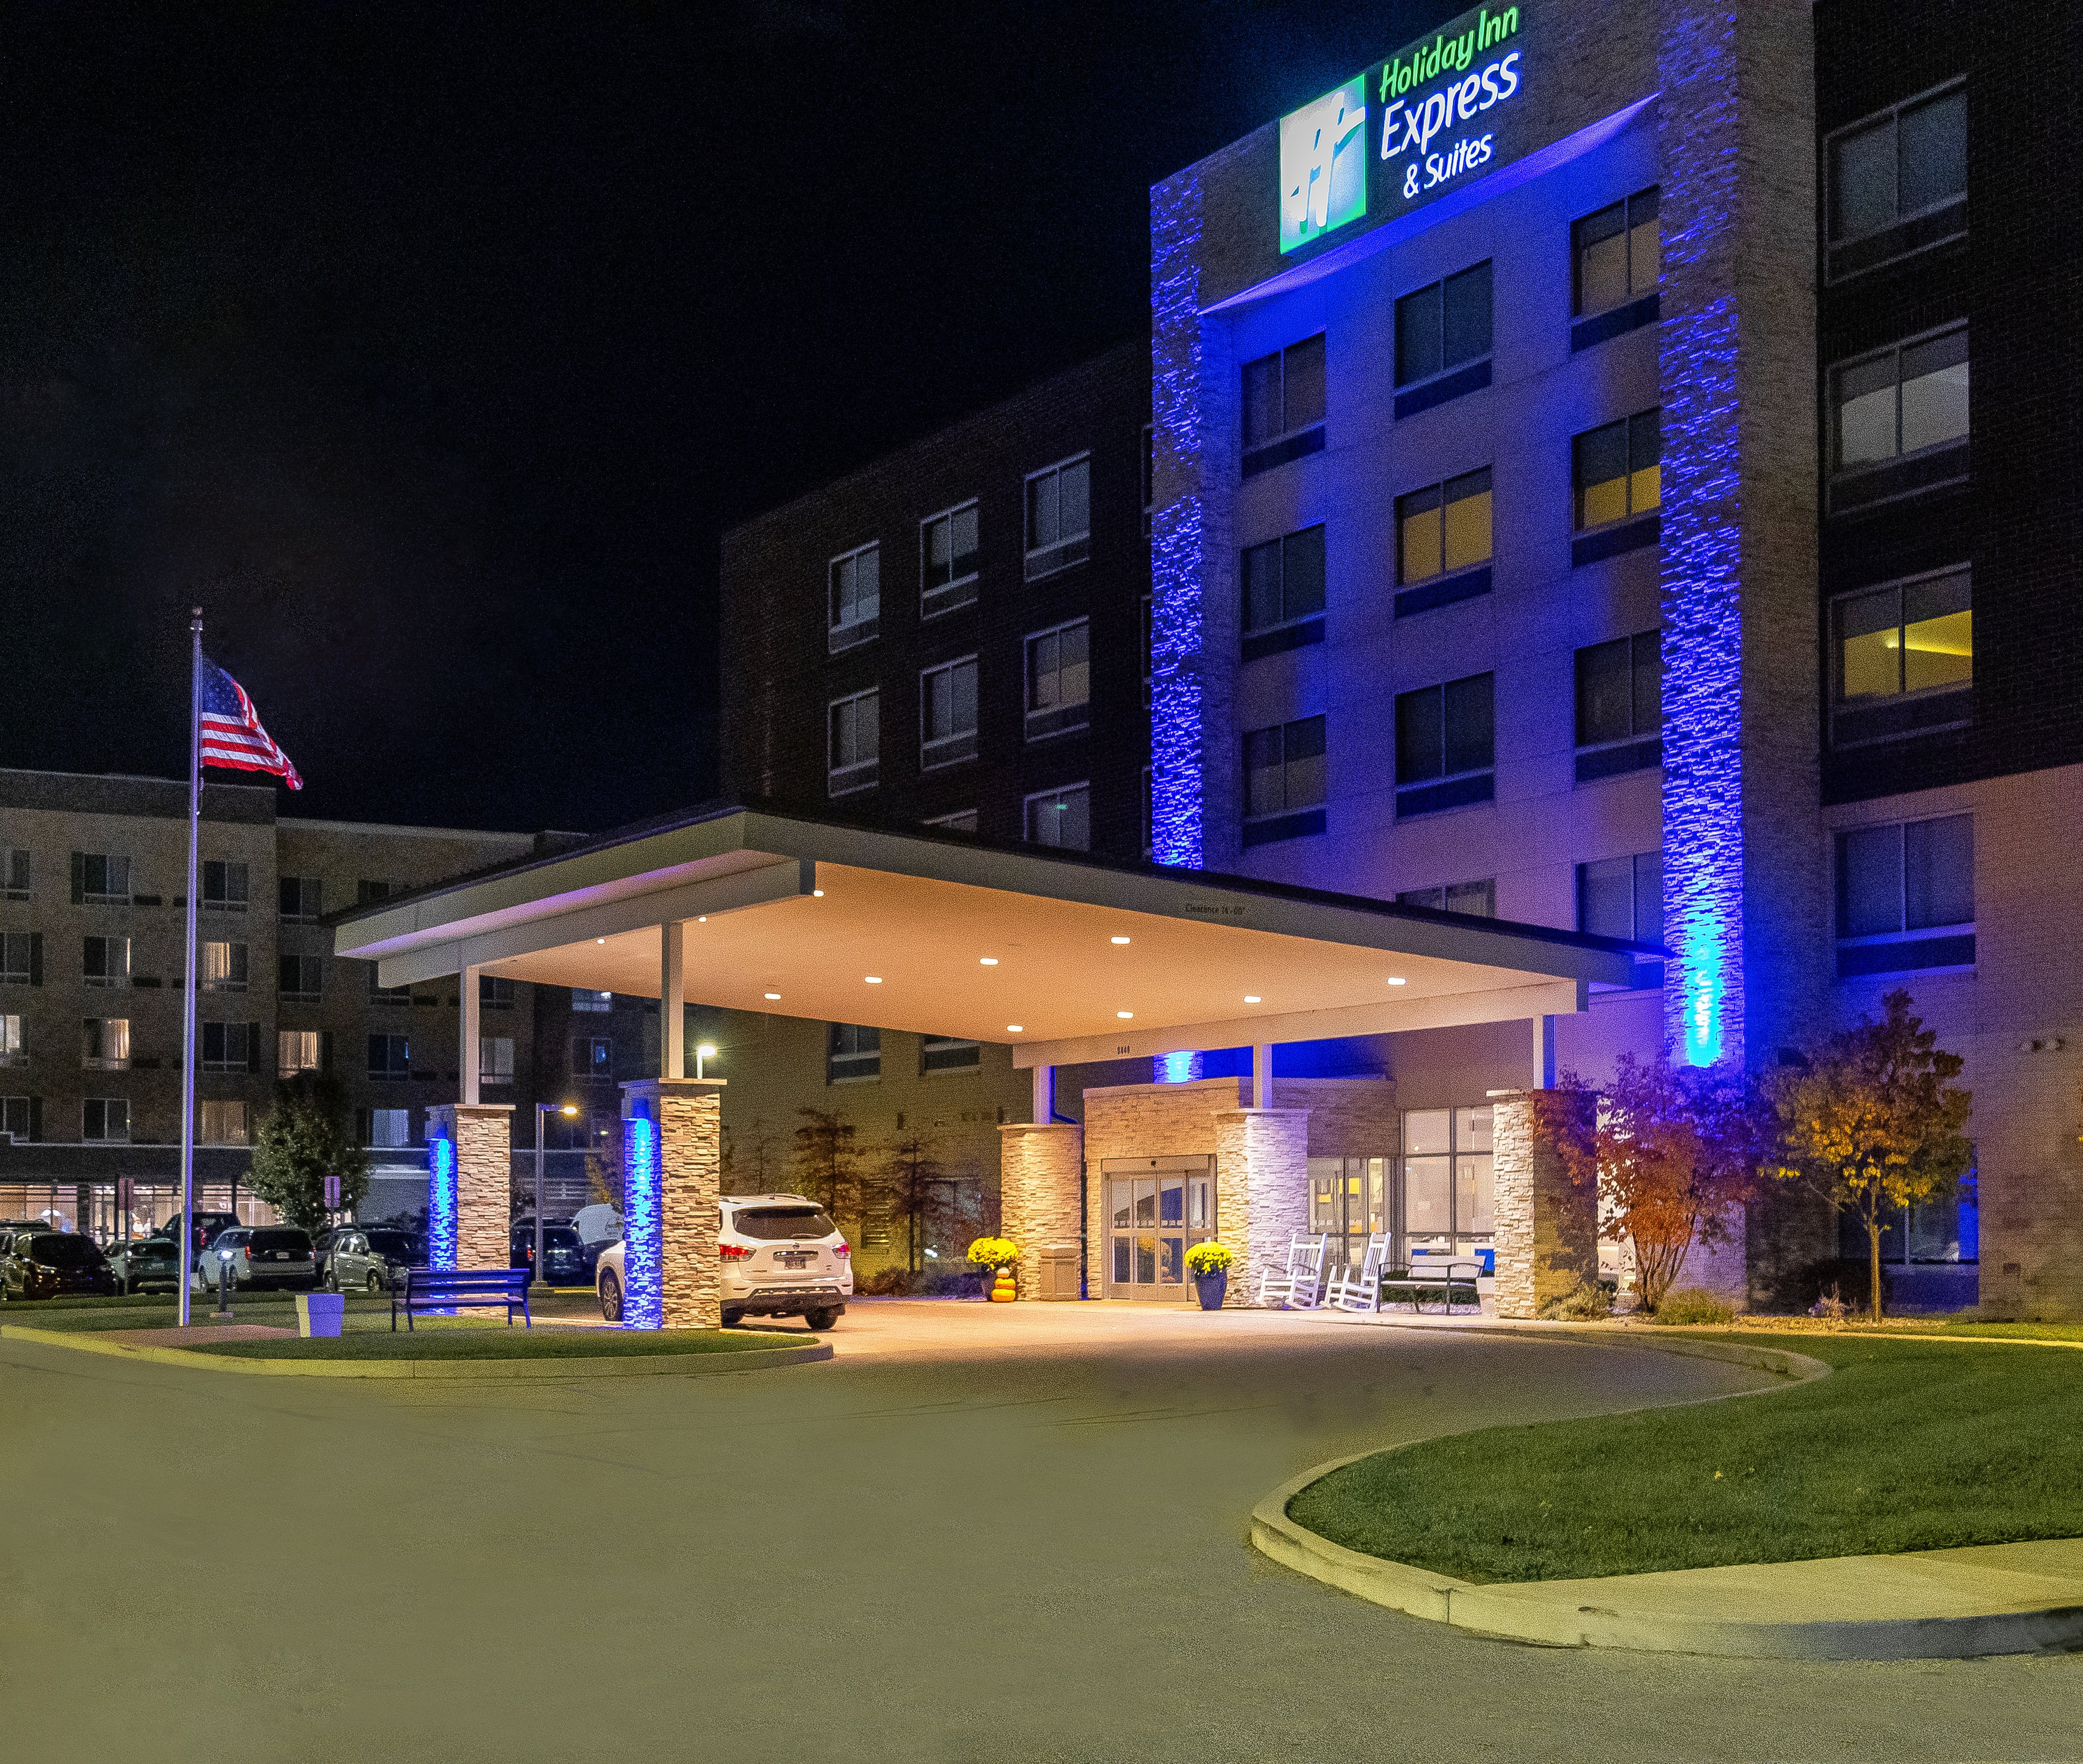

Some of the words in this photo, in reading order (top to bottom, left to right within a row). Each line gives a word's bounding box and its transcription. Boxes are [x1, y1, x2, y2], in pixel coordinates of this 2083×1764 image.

[1380, 30, 1475, 103] Holiday
[1477, 6, 1519, 51] Inn
[1381, 52, 1520, 161] Express
[1403, 164, 1419, 199] &
[1423, 134, 1494, 189] Suites
[1185, 904, 1219, 914] Clearance
